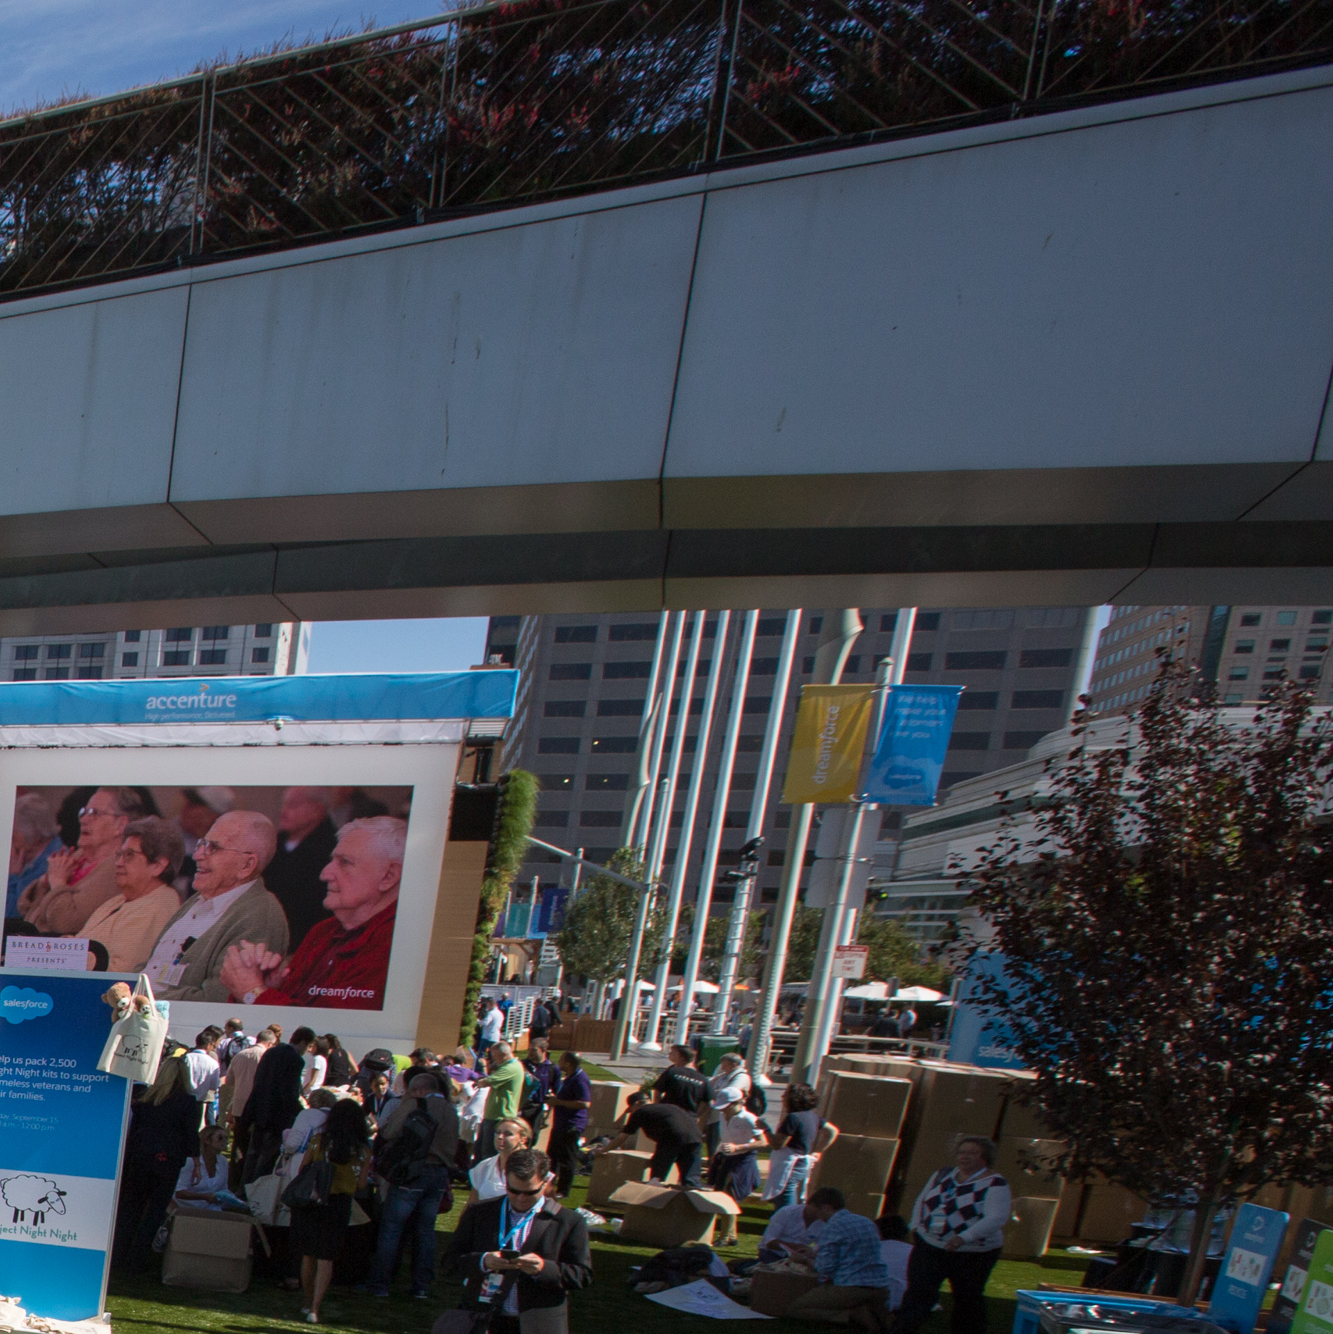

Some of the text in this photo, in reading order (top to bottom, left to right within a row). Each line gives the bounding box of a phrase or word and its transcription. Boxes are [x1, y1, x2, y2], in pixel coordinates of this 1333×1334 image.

[146, 692, 237, 709] accenture
[811, 705, 840, 784] dreamforce
[11, 941, 45, 950] BREAD
[53, 942, 85, 952] ROSES
[308, 984, 375, 1000] dreamforce
[3, 999, 49, 1010] salesforce
[12, 1056, 24, 1064] us
[25, 1057, 48, 1067] pack
[49, 1058, 77, 1069] 2,500
[15, 1067, 40, 1079] Night
[42, 1069, 59, 1079] kits
[60, 1071, 71, 1080] to
[71, 1073, 110, 1083] support
[32, 1081, 71, 1092] veterans
[72, 1084, 92, 1093] and
[8, 1090, 46, 1101] families.
[12, 1113, 48, 1123] September
[20, 1225, 47, 1239] Night
[49, 1228, 78, 1243] Night
